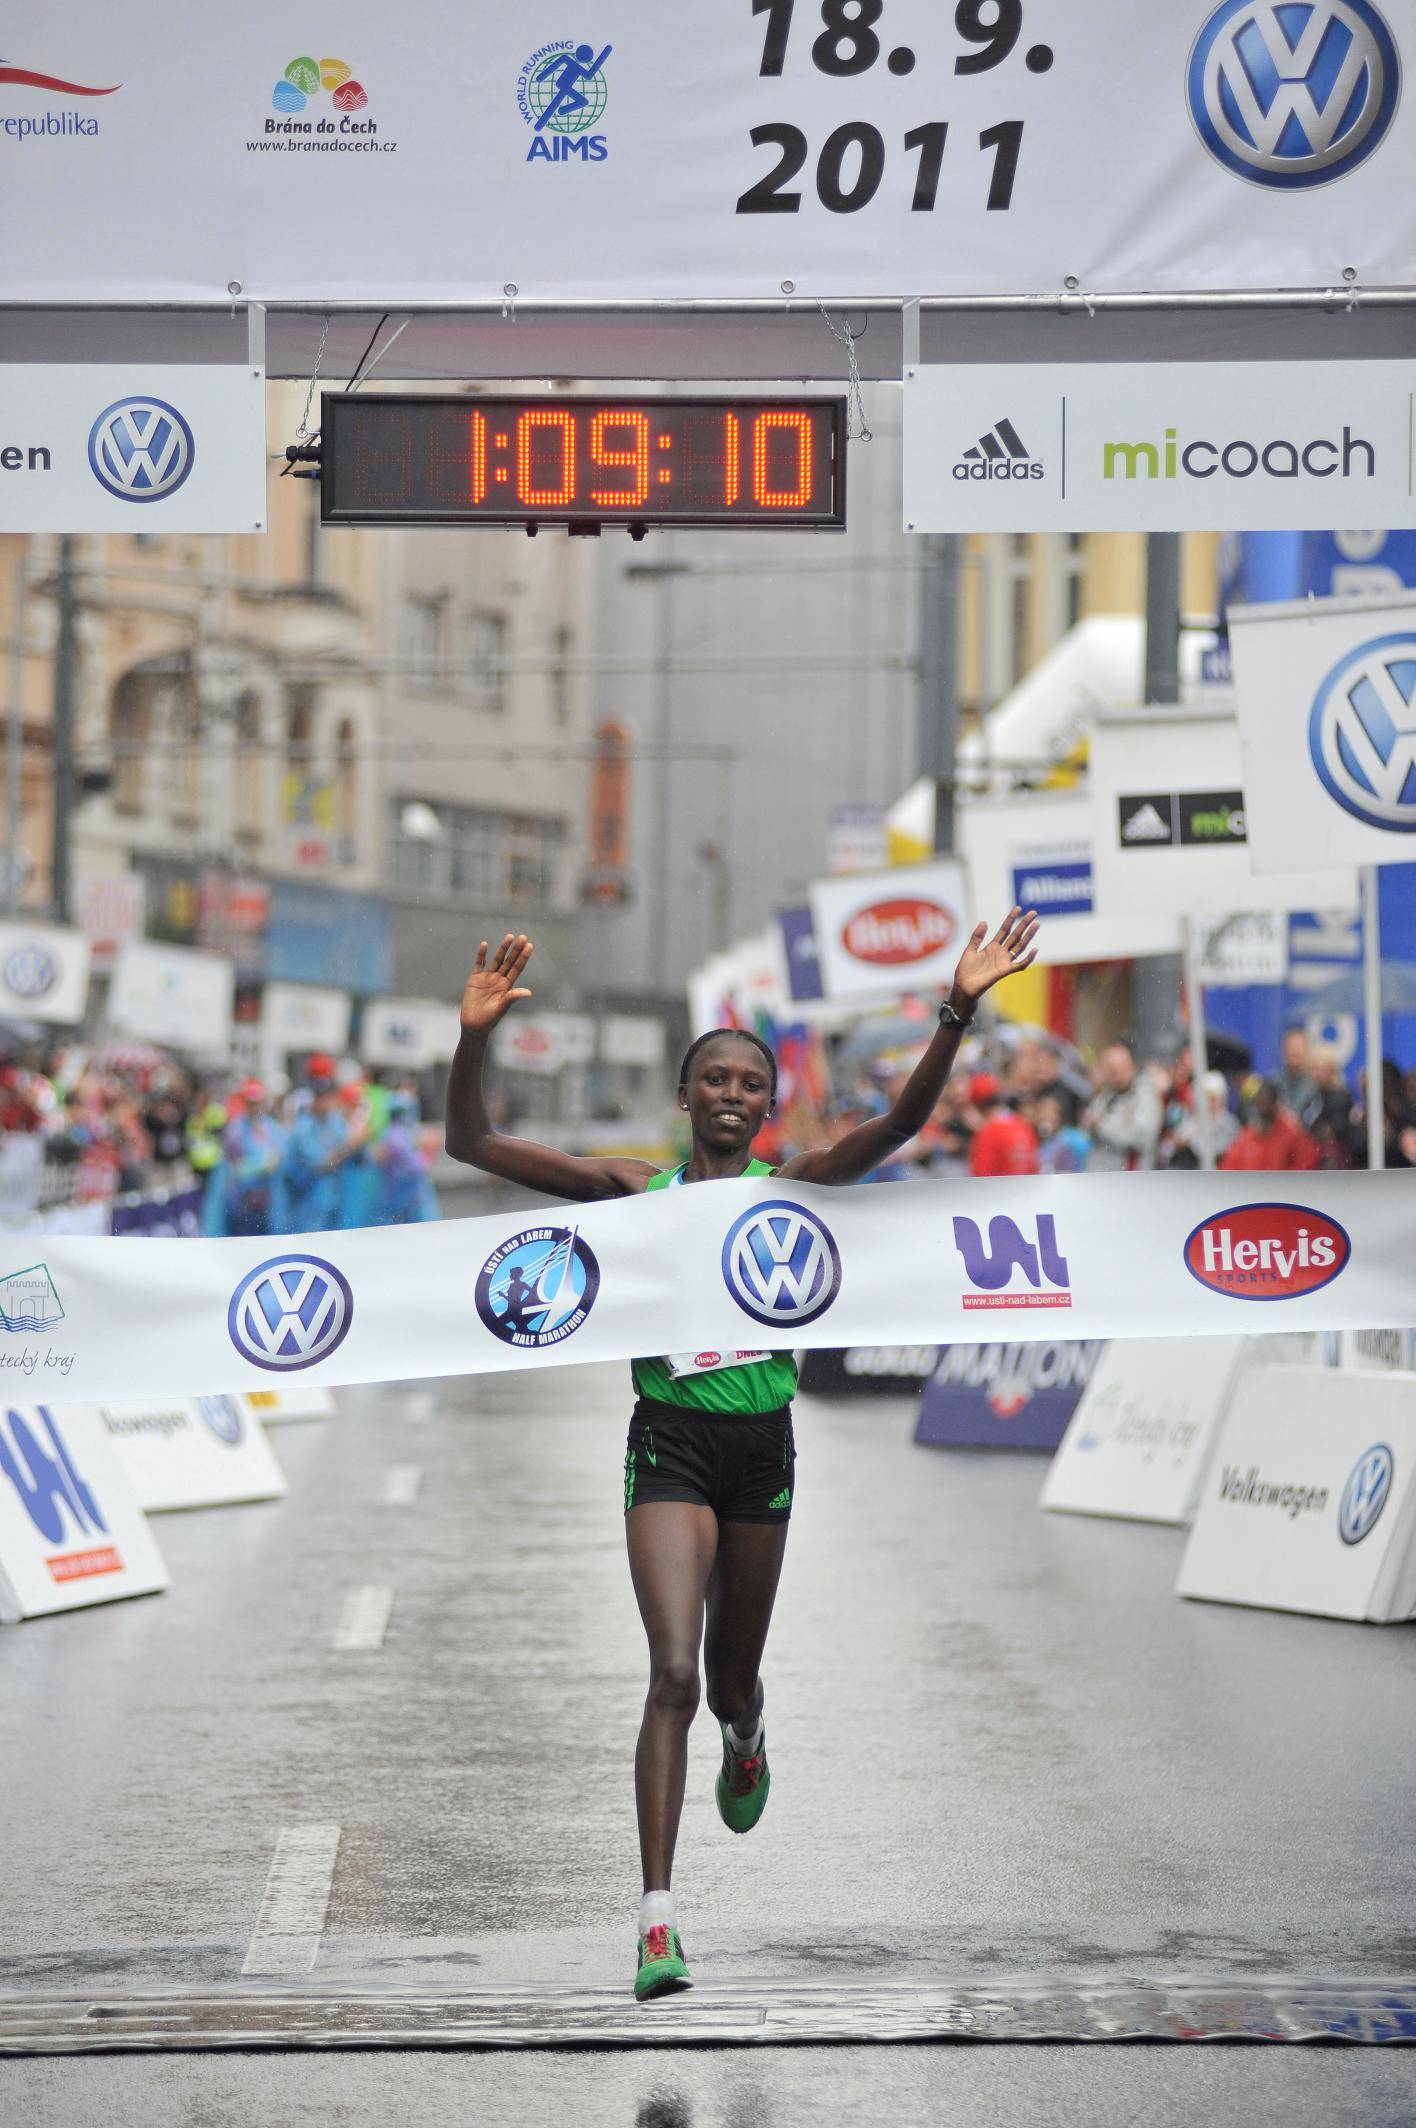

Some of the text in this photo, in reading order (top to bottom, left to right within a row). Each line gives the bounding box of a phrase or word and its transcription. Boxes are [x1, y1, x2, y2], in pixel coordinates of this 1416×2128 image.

[517, 40, 574, 125] WORLD RUNNING
[264, 115, 377, 134] Brána do Čech
[245, 138, 398, 152] www.branadocech.cz
[526, 135, 609, 162] AIMS
[735, 120, 1025, 214] 2011
[0, 446, 52, 471] en
[1103, 425, 1375, 480] micoach
[951, 457, 1045, 481] adidas
[502, 1239, 520, 1255] NAD
[520, 1229, 553, 1245] LABEM
[1201, 1228, 1336, 1278] Hervis
[1216, 1272, 1279, 1284] SPORTS
[963, 1295, 1071, 1306] www.usti-nad-labem.cz
[511, 1308, 587, 1346] HALF MARATHON
[43, 1346, 77, 1376] kraj
